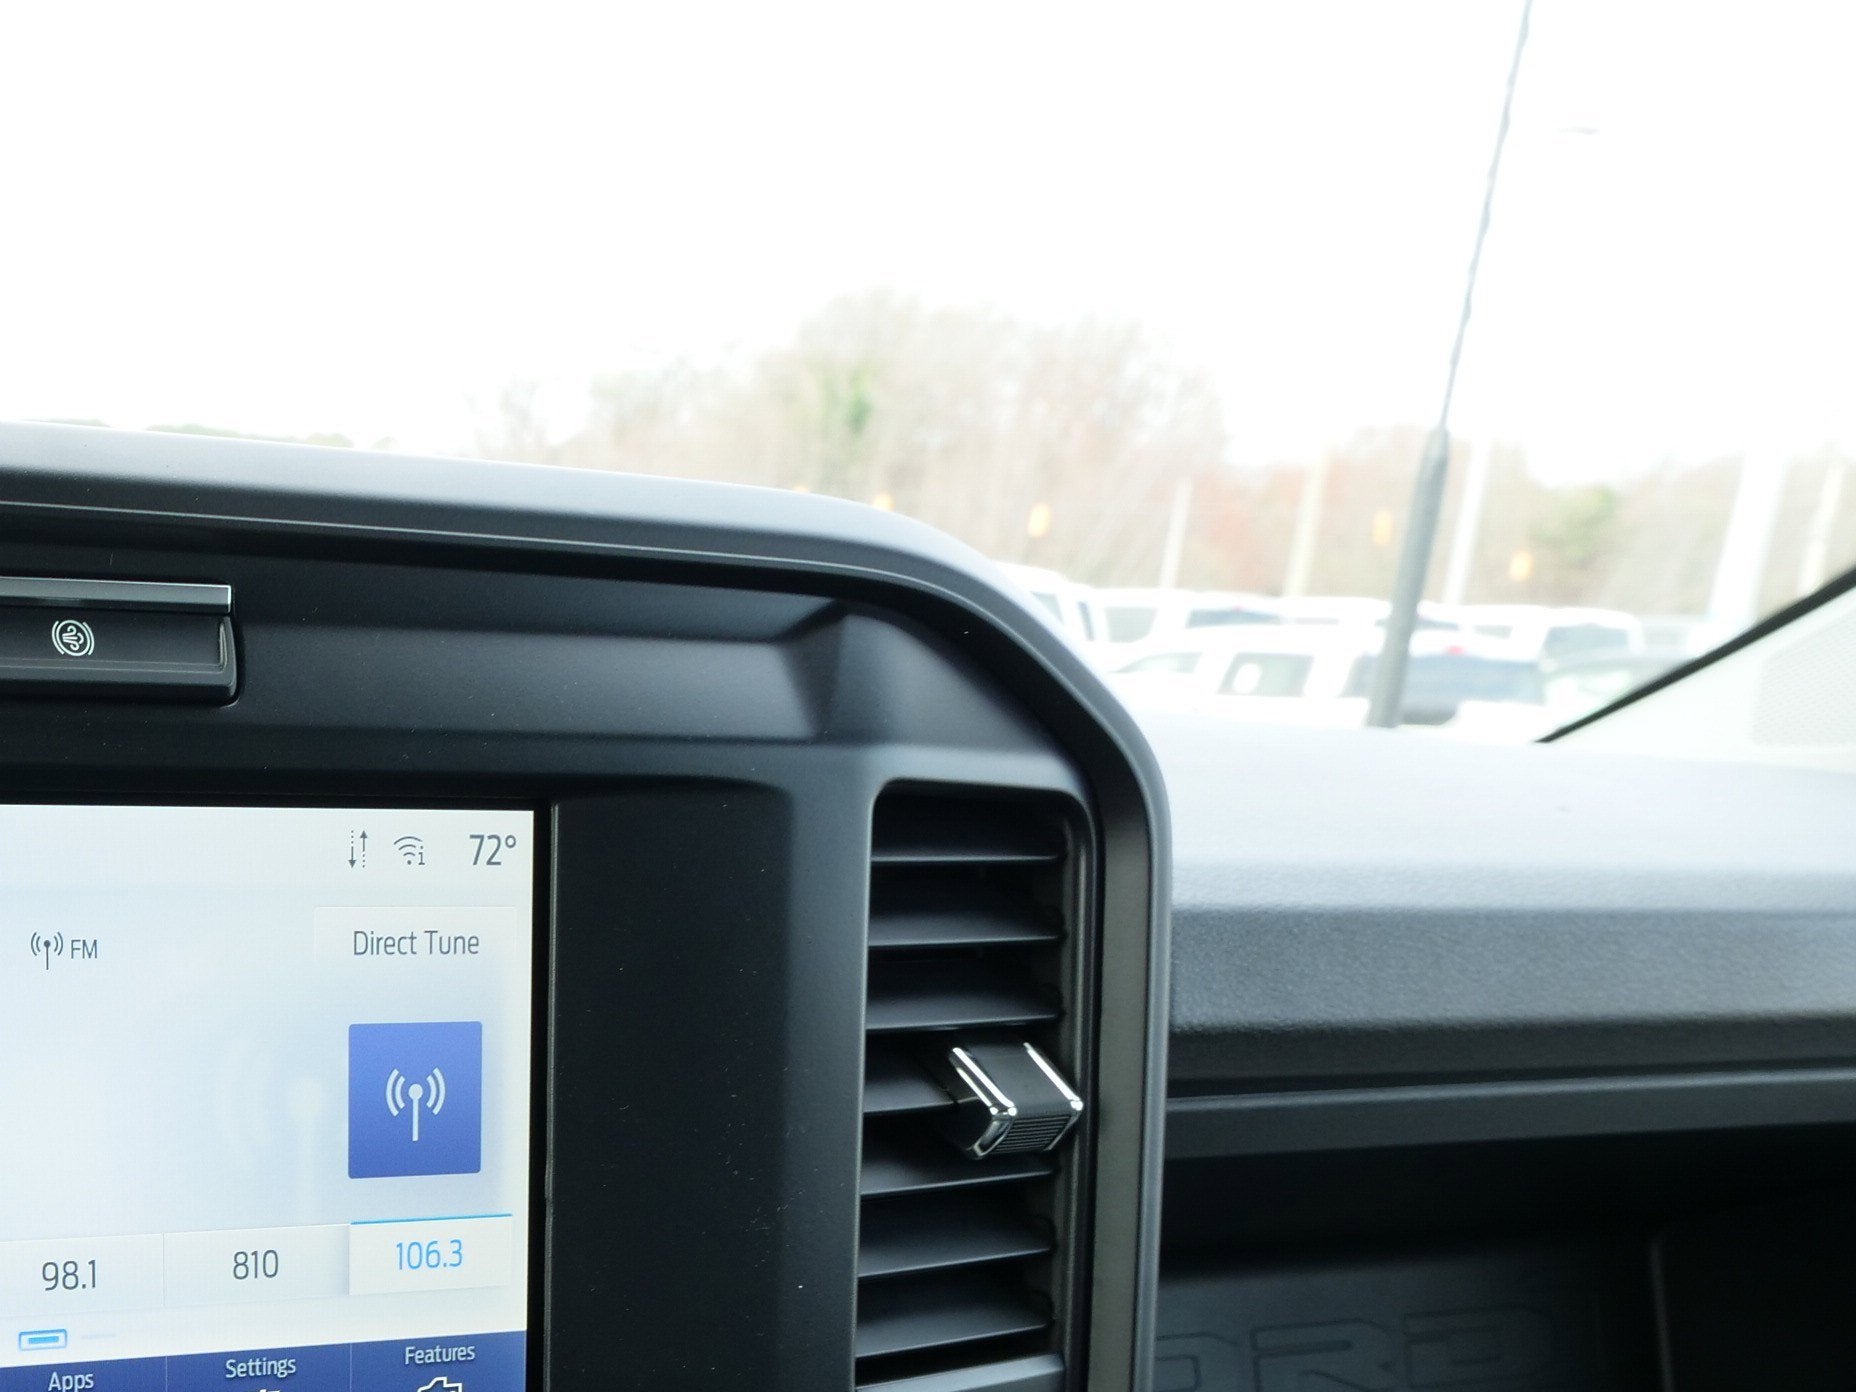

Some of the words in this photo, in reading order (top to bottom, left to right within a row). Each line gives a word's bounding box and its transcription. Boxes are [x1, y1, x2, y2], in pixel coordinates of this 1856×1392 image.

[469, 833, 517, 866] 72°
[70, 939, 99, 960] FM
[353, 930, 418, 956] Direct
[424, 930, 480, 955] Tune
[232, 1249, 279, 1280] 810
[395, 1239, 463, 1271] 106.3
[42, 1259, 97, 1292] 98.1
[225, 1356, 297, 1382] Settings
[404, 1345, 476, 1366] Features
